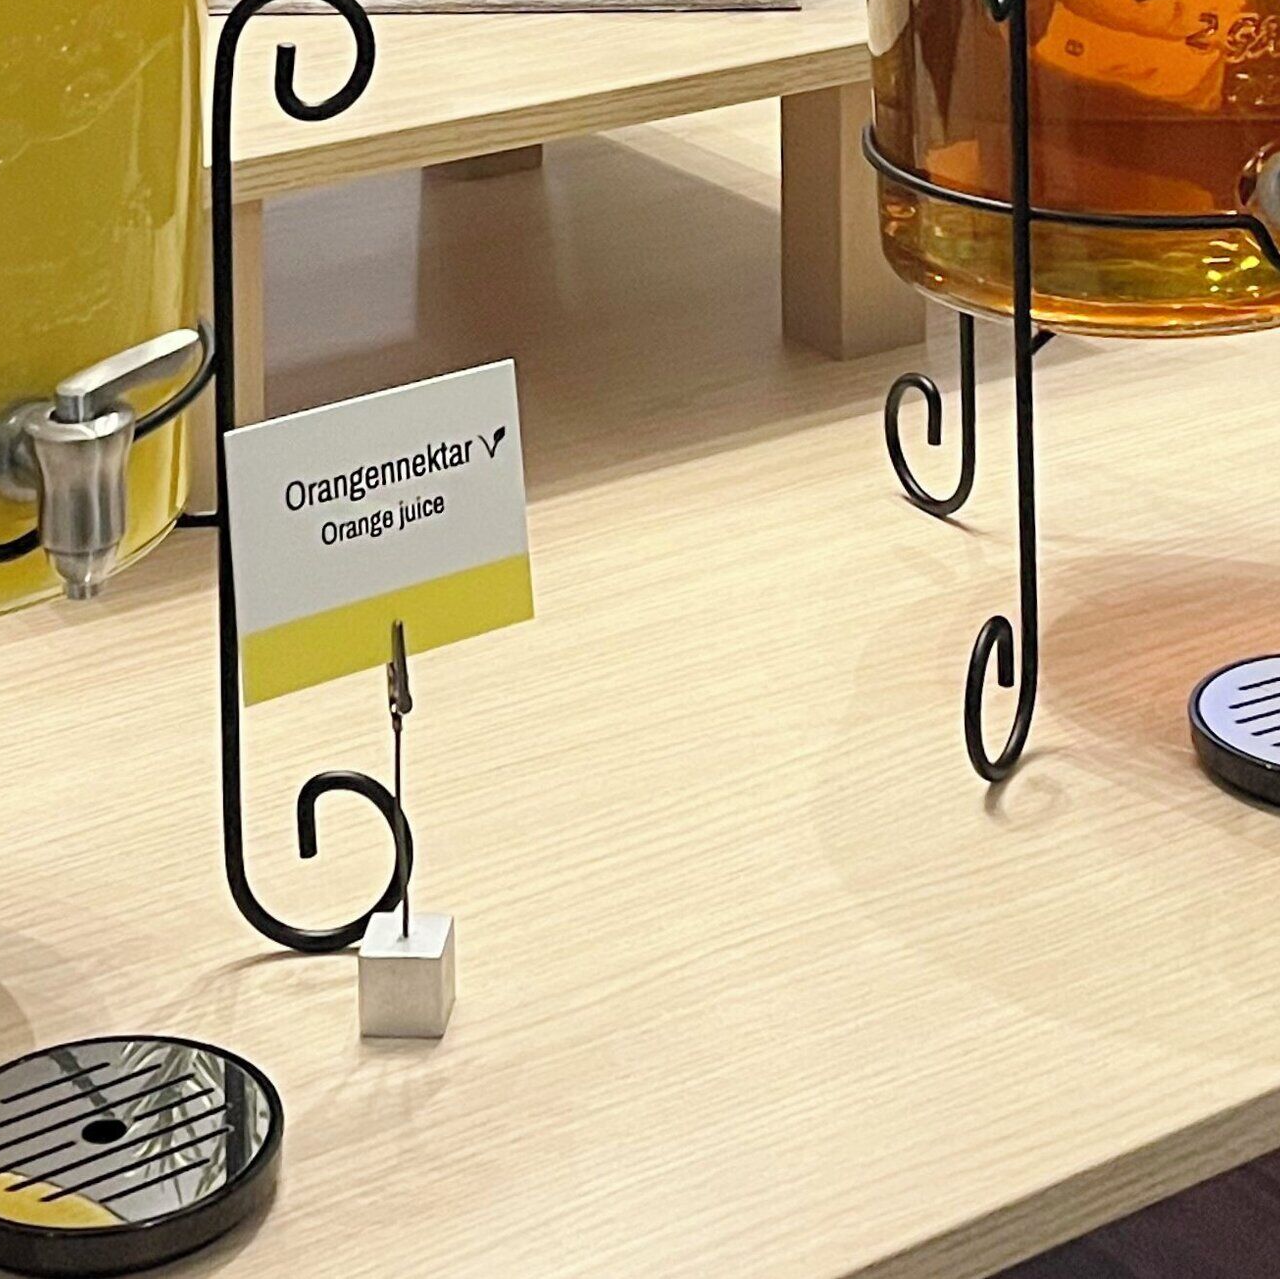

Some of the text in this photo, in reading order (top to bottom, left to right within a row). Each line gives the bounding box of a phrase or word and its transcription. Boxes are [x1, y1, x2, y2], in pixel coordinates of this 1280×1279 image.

[285, 440, 473, 512] Orangennektar
[321, 495, 445, 545] Orange juice
